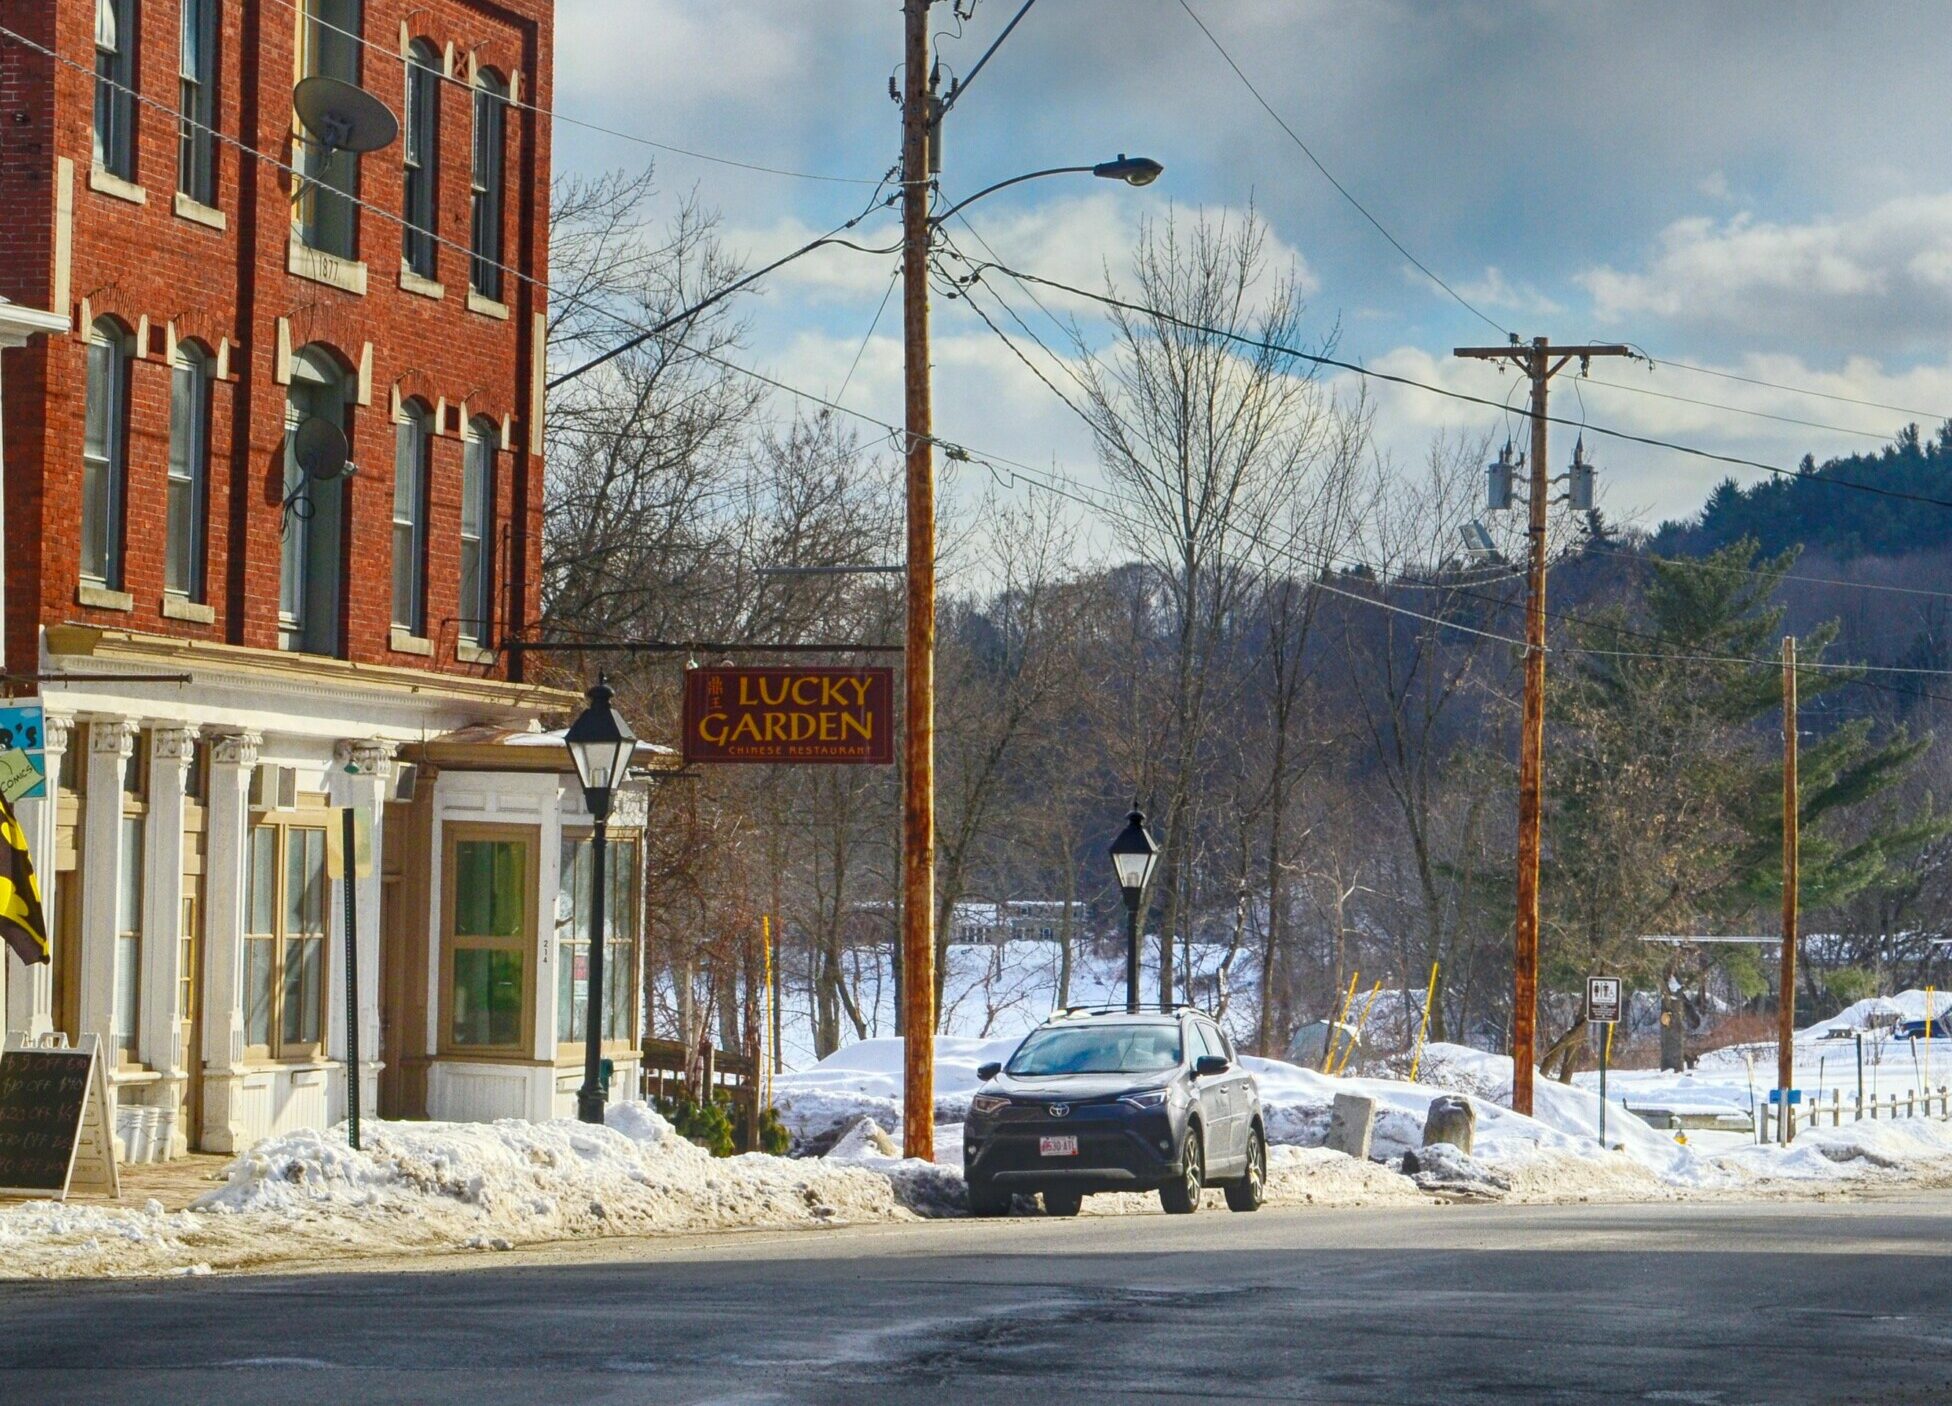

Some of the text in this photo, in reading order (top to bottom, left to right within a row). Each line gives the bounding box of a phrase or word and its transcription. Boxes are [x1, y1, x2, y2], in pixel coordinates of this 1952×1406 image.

[319, 255, 339, 281] 1877
[739, 676, 873, 706] LUCKY
[699, 712, 873, 747] GARDEN
[728, 746, 872, 755] CHINESE RESTAURANT
[0, 765, 33, 793] COMICS
